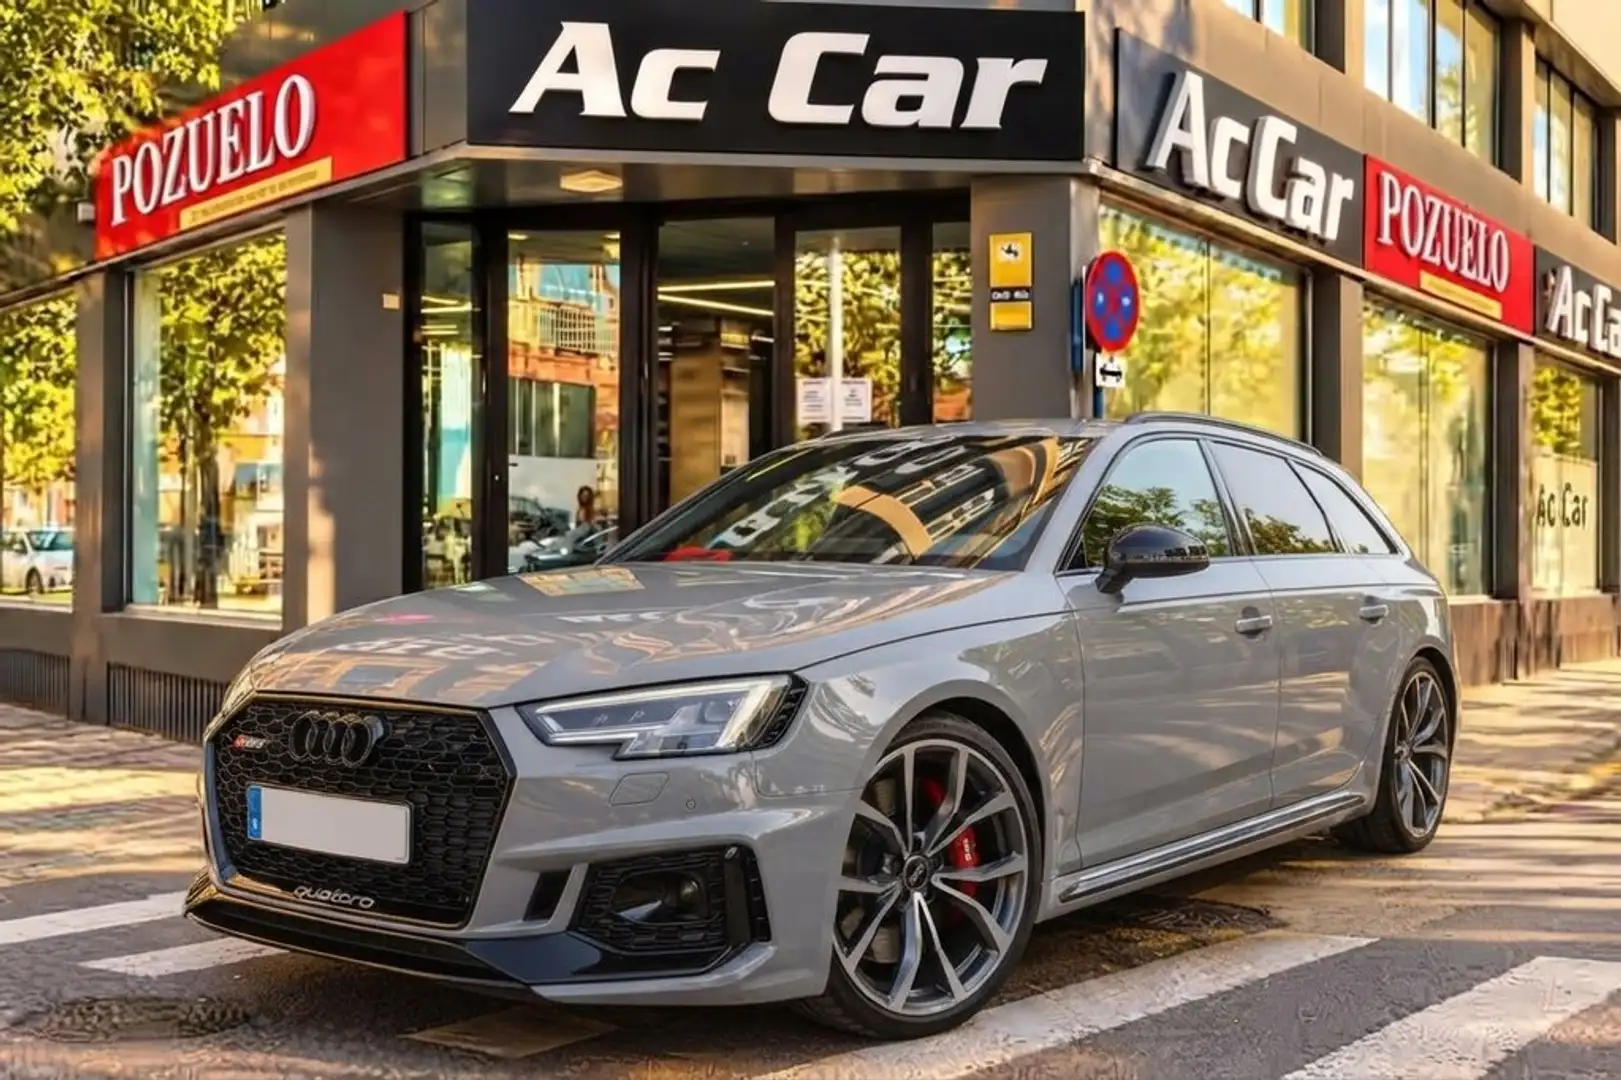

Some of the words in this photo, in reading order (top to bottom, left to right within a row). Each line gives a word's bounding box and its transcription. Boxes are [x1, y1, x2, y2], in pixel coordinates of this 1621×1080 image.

[508, 21, 721, 121] Ac
[768, 31, 1048, 129] Car
[110, 73, 316, 227] POZUELO
[1376, 171, 1510, 293] POZUELO
[1536, 483, 1556, 528] Ac
[1562, 482, 1589, 531] Car
